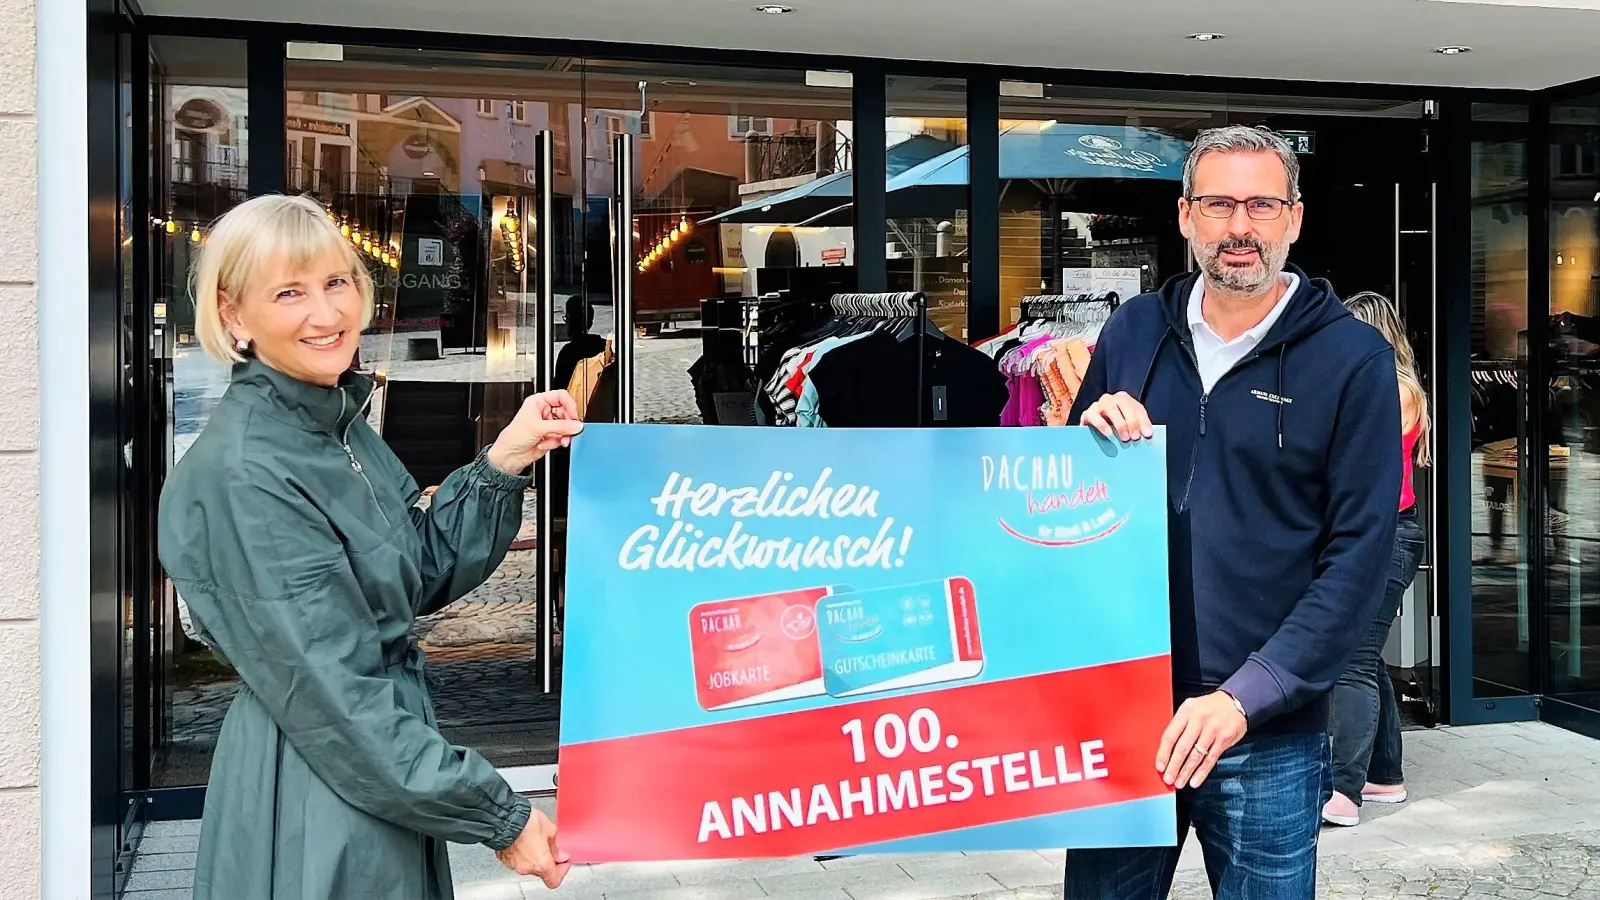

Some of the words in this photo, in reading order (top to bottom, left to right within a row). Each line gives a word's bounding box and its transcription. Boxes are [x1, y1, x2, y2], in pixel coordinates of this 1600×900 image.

[373, 273, 461, 289] USGANG
[981, 453, 1073, 492] DACHAU
[650, 467, 879, 519] Herzlichen
[1026, 478, 1110, 516] handelt
[618, 517, 913, 572] Glückwunsch!
[701, 614, 741, 634] DACHAU
[826, 606, 864, 625] DACHAU
[708, 665, 772, 690] JOBKARTE
[834, 645, 936, 675] GUTSCHEINKARTE
[841, 707, 959, 763] 100.
[697, 739, 1109, 843] ANNAHMESTELLE
